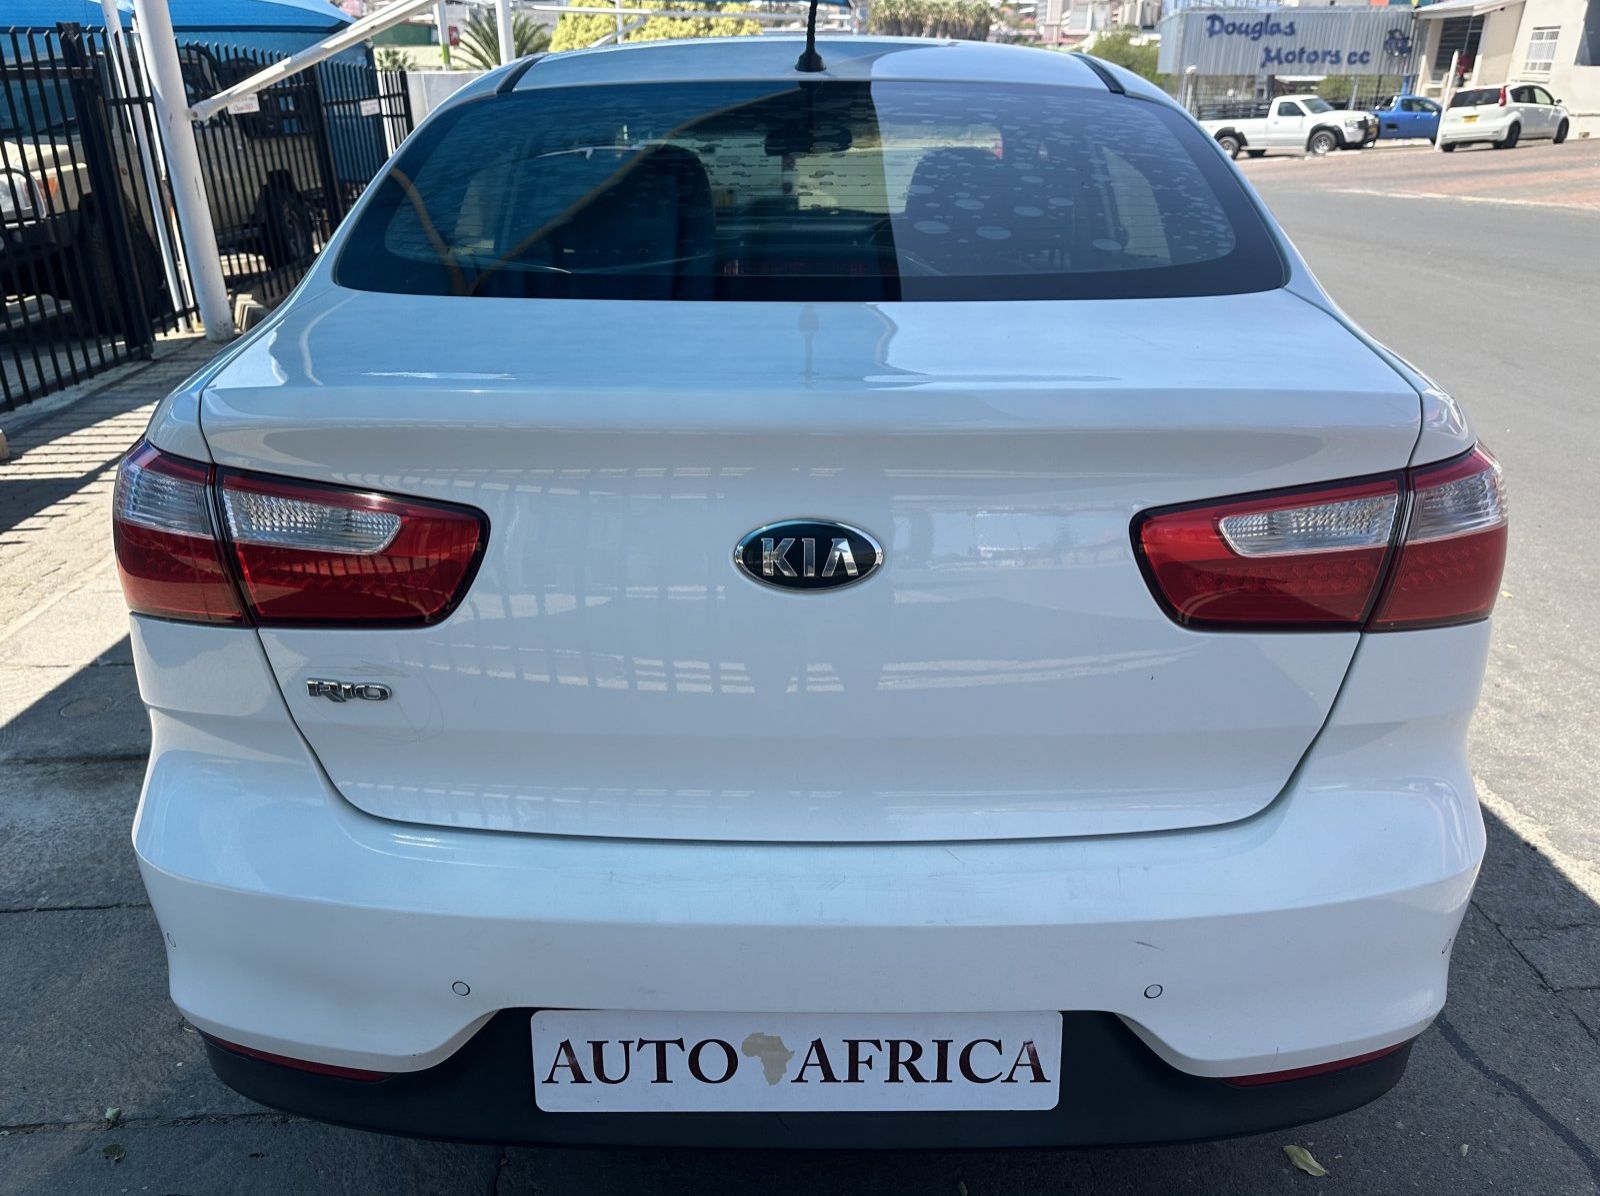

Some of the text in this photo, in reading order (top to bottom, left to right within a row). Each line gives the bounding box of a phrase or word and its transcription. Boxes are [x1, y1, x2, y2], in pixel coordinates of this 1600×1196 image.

[1206, 13, 1296, 41] Douglas
[1260, 46, 1371, 68] Motors cc
[760, 537, 859, 577] KIA
[305, 678, 392, 703] RIO
[541, 1036, 1052, 1085] AUTO AFRICA
